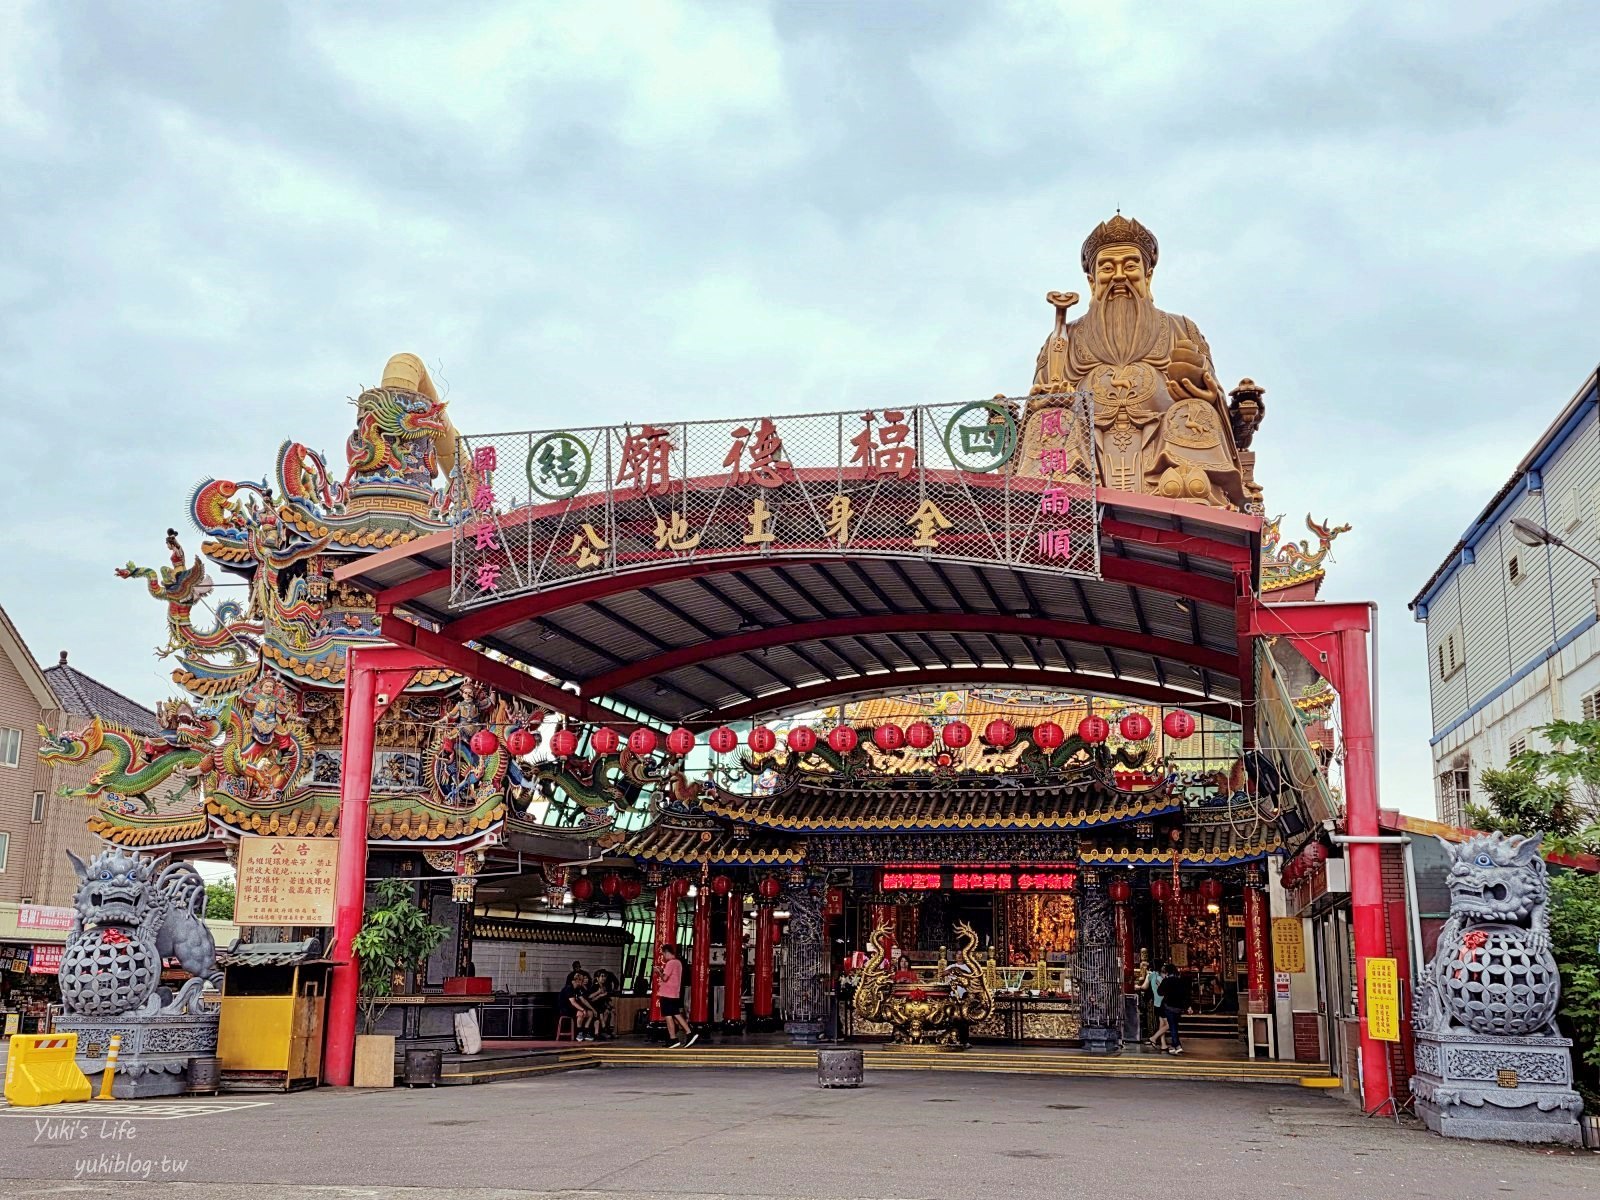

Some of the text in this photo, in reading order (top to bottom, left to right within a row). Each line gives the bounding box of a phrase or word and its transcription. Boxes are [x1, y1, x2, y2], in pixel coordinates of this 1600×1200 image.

[1038, 408, 1072, 560] 風調雨順
[270, 842, 311, 856] 公告
